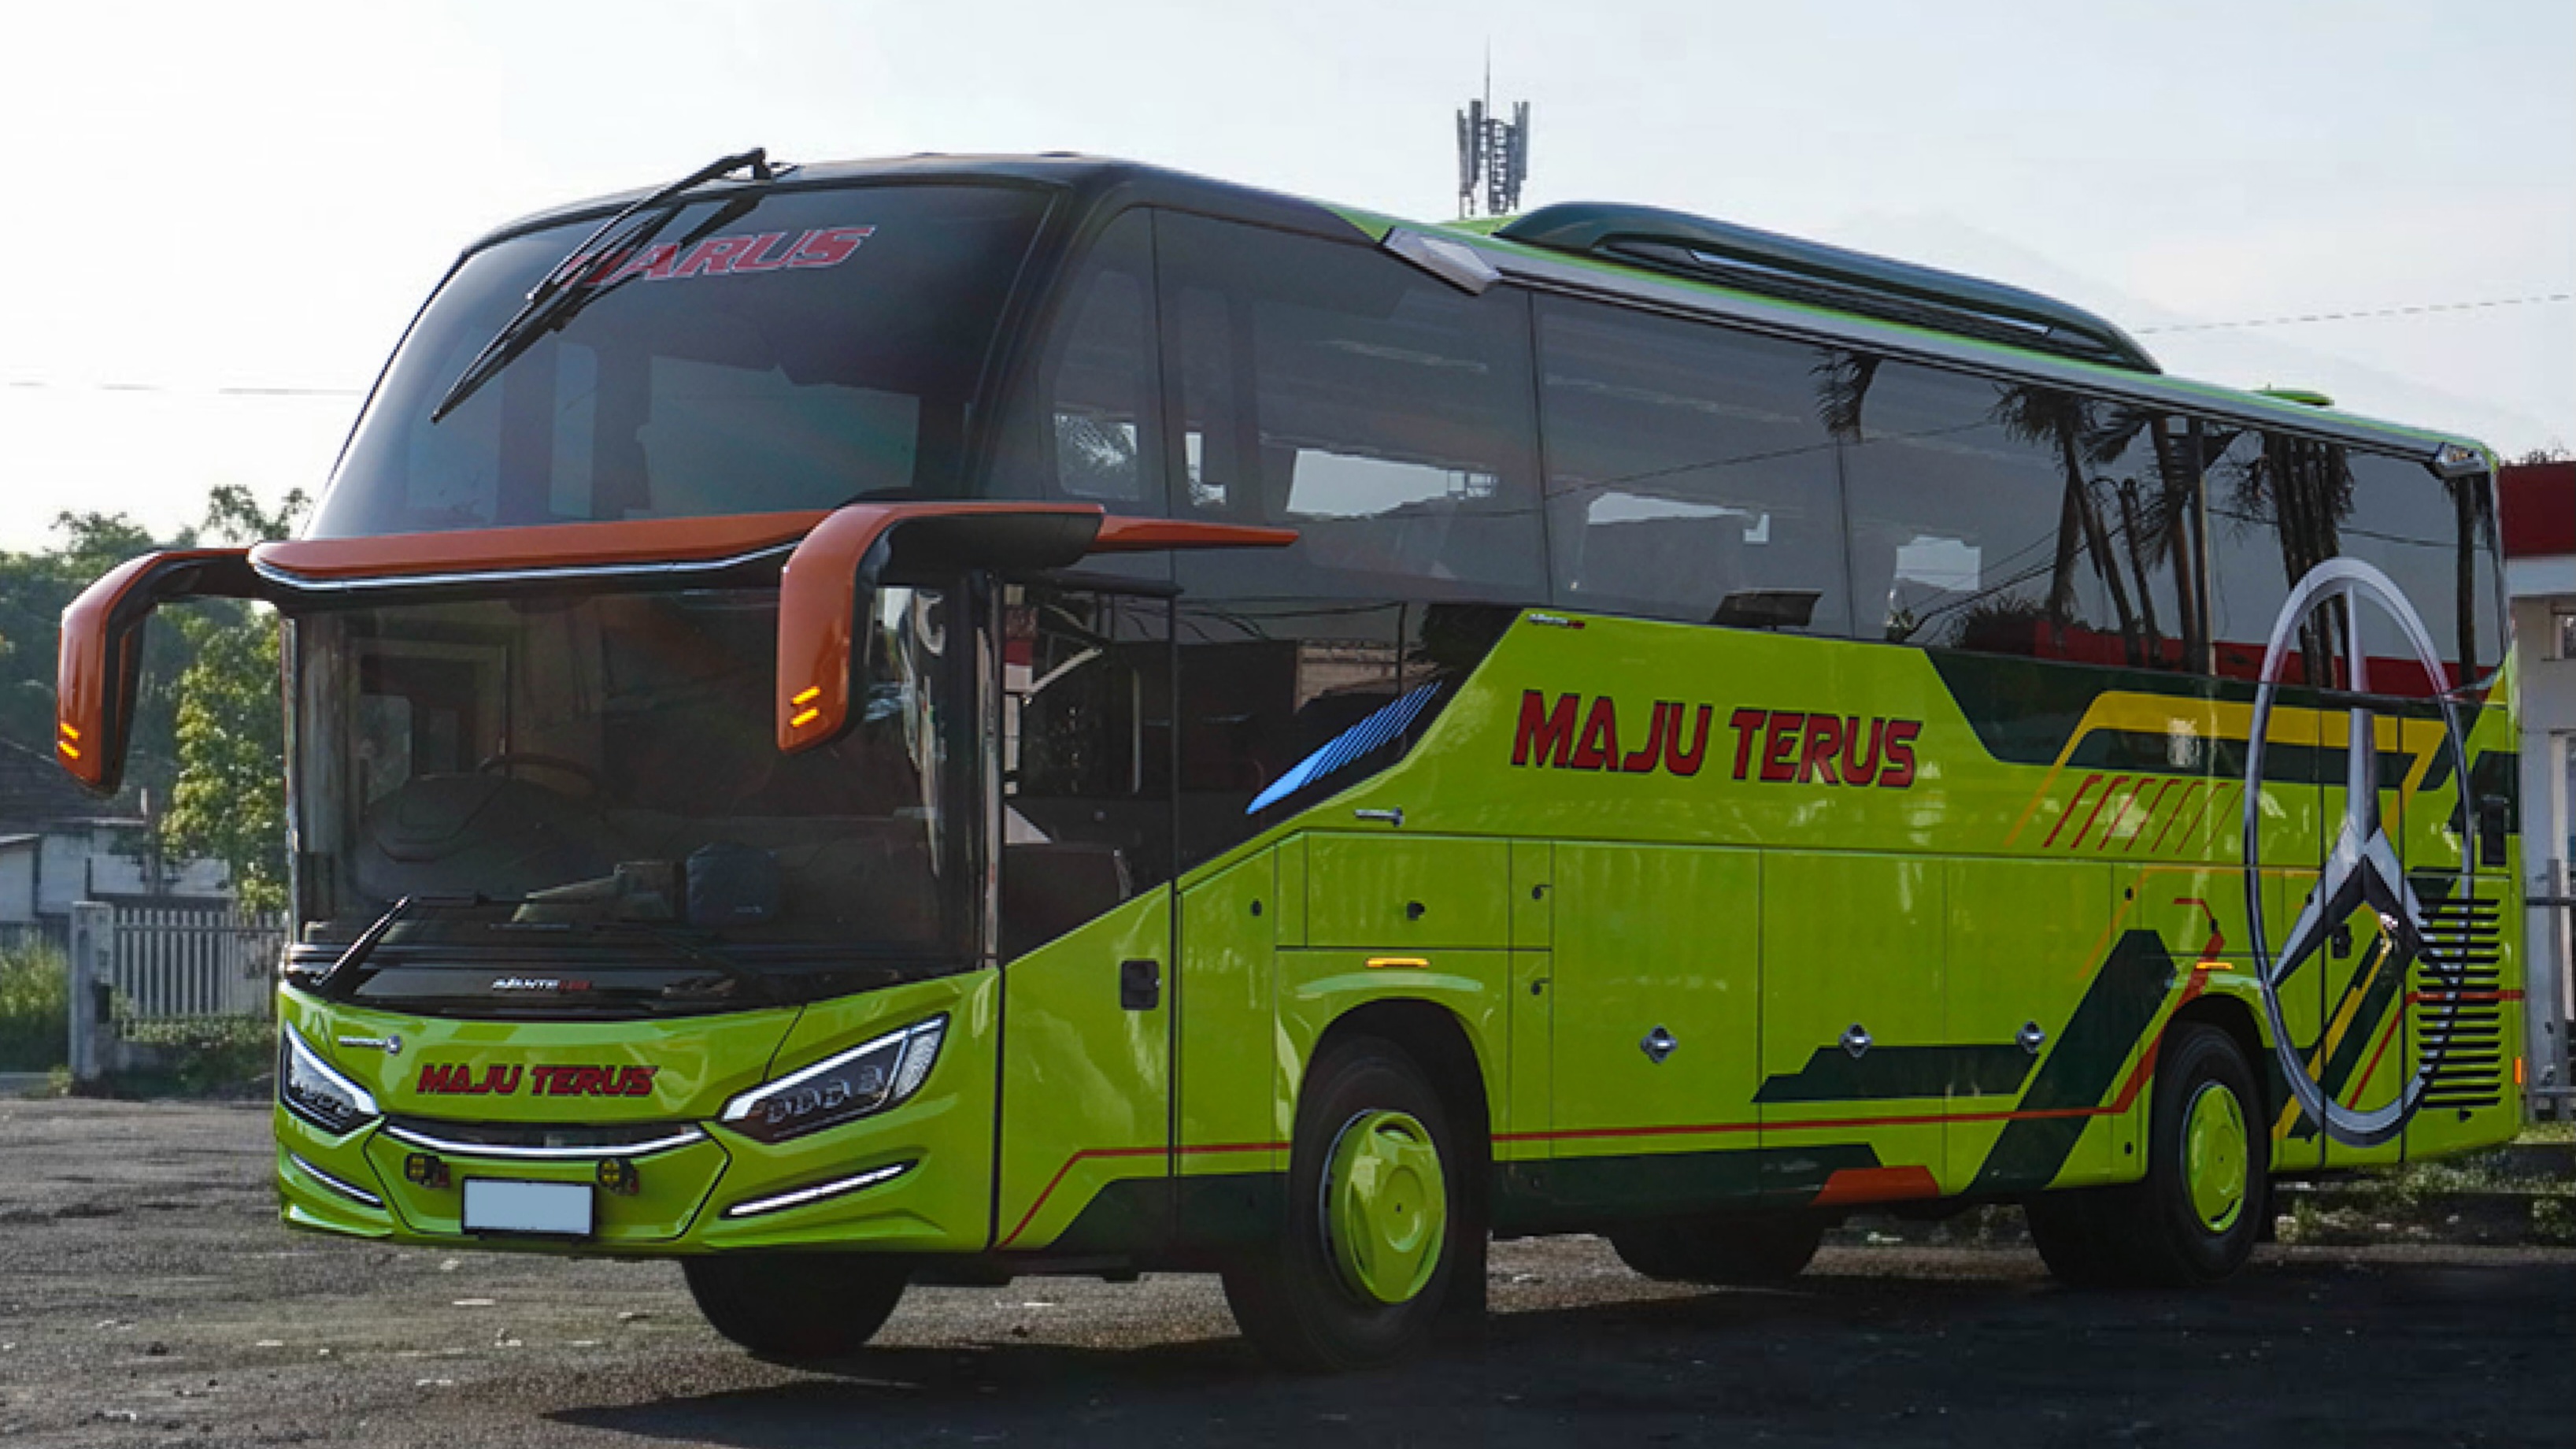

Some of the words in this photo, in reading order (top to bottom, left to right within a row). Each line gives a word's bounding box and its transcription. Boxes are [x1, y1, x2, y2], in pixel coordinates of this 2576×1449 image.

[1511, 690, 1712, 776] MAJU
[1729, 709, 1923, 788] TERUS
[416, 1064, 523, 1095] MAJU
[530, 1065, 659, 1095] TERUS
